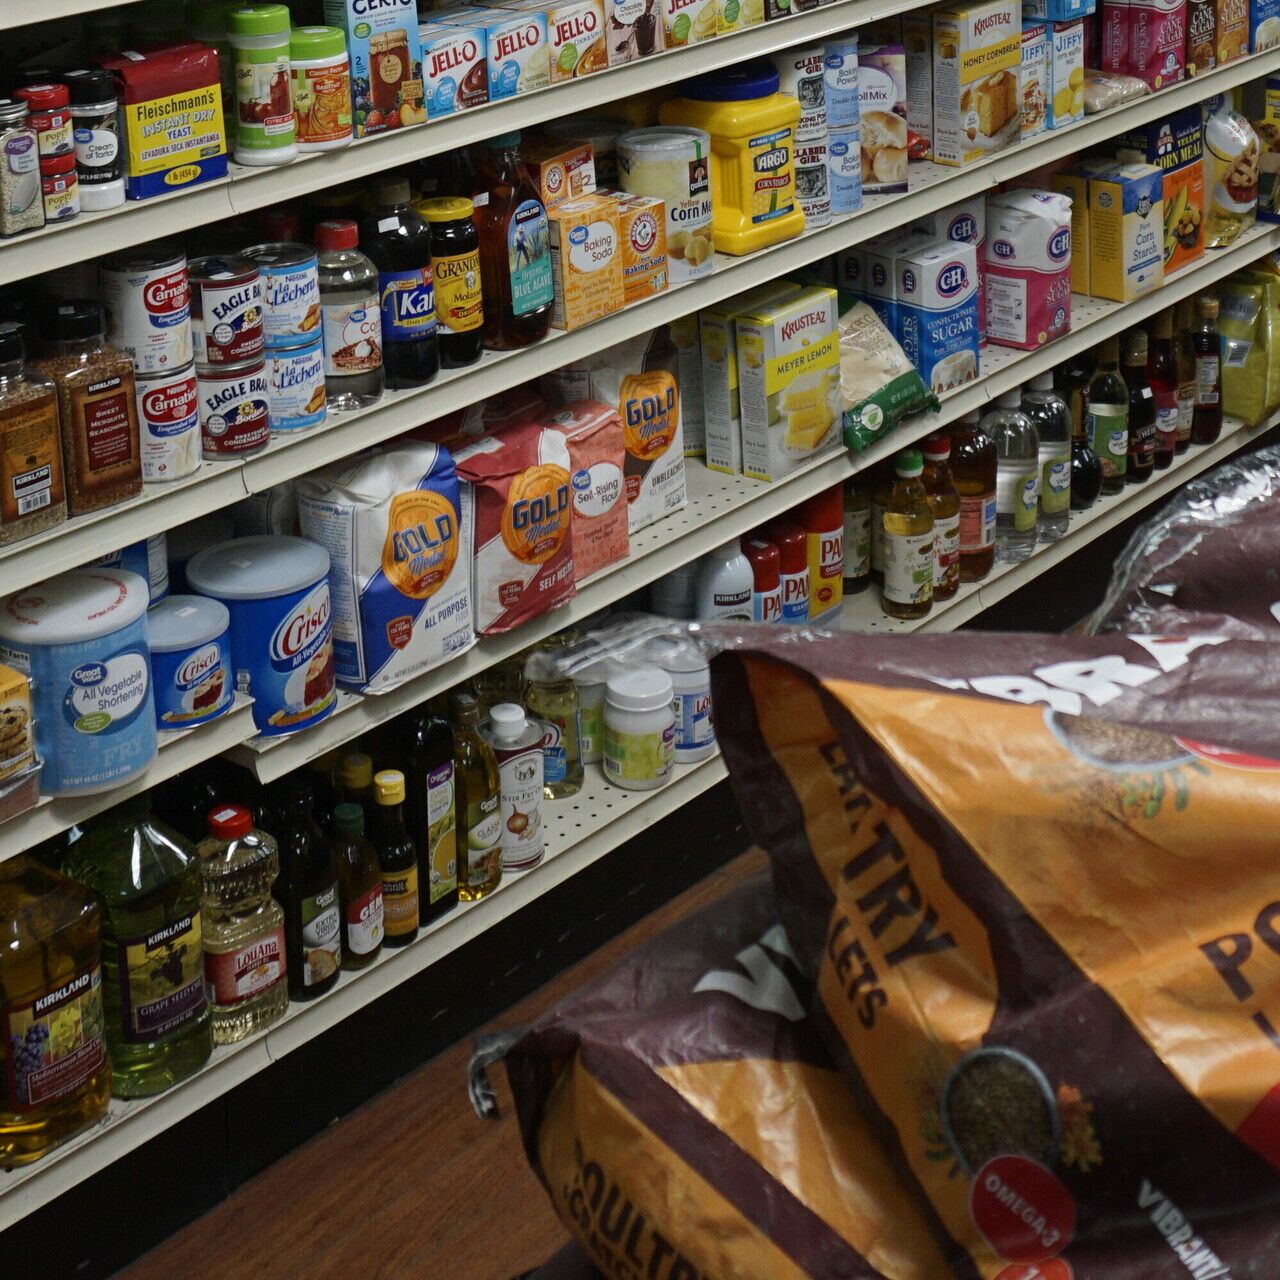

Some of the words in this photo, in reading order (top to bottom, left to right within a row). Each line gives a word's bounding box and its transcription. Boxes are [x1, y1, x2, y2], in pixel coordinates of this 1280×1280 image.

[973, 10, 1012, 33] KRUSTEAZ
[1055, 31, 1083, 52] JIFFY
[963, 53, 985, 69] HONEY
[986, 39, 1020, 64] CORNBREAD
[136, 90, 215, 122] Fleischmann's
[141, 112, 189, 138] INSTANT
[191, 108, 215, 126] DRY
[167, 126, 192, 141] YEAST
[756, 150, 787, 172] ARGO
[584, 234, 612, 252] Baking
[1135, 232, 1155, 246] Corn
[592, 247, 613, 262] Soda
[1133, 242, 1159, 261] Starch
[776, 355, 803, 377] MEYER
[804, 341, 833, 365] LEMON
[206, 386, 245, 411] EAGLE
[34, 972, 90, 1013] KIRKLAND
